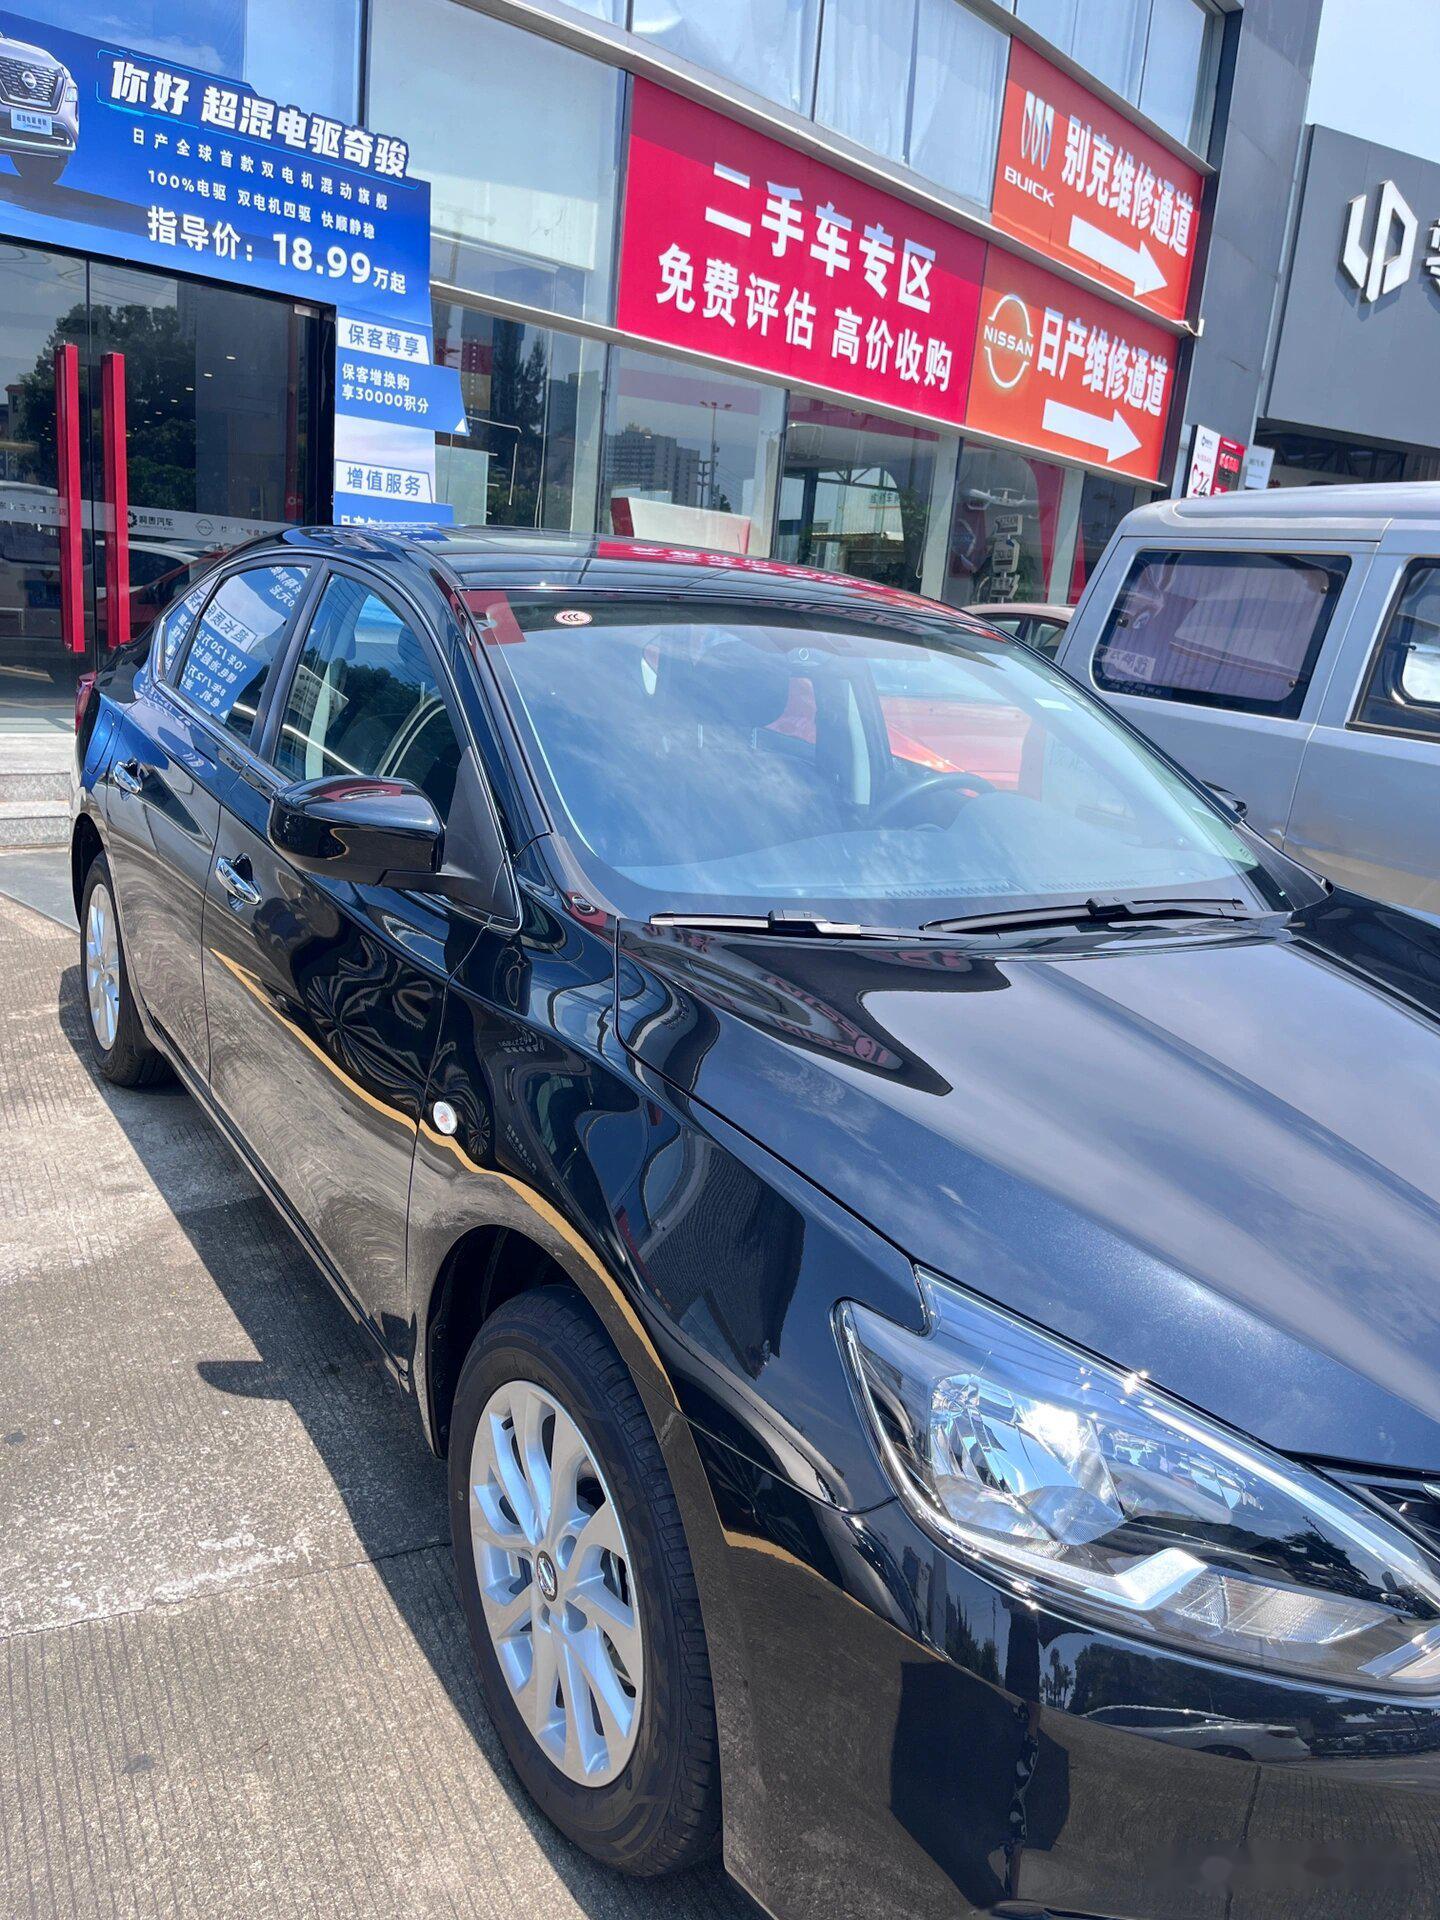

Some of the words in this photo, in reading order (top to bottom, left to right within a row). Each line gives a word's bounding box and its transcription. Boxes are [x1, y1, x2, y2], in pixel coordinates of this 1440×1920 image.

[111, 60, 190, 115] 你好
[201, 86, 409, 179] 超混电驱奇骏
[133, 128, 389, 211] 日产全球首款双电机混动旗舰
[1003, 165, 1055, 208] BUICK
[1061, 114, 1194, 257] 别克维修通道
[148, 170, 227, 202] 100%电驱
[238, 188, 311, 224] 双电机四驱
[321, 211, 375, 240] 快顺静稳
[705, 162, 936, 313] 二手车专区
[349, 323, 420, 357] 保客尊享
[656, 242, 816, 349] 免费评估
[831, 306, 953, 393] 高价收购
[984, 325, 1033, 357] NISSAN
[342, 363, 410, 390] 保客增换购
[1037, 306, 1168, 418] 日产维修通道
[342, 386, 429, 415] 享30000积分
[347, 467, 420, 496] 增值服务
